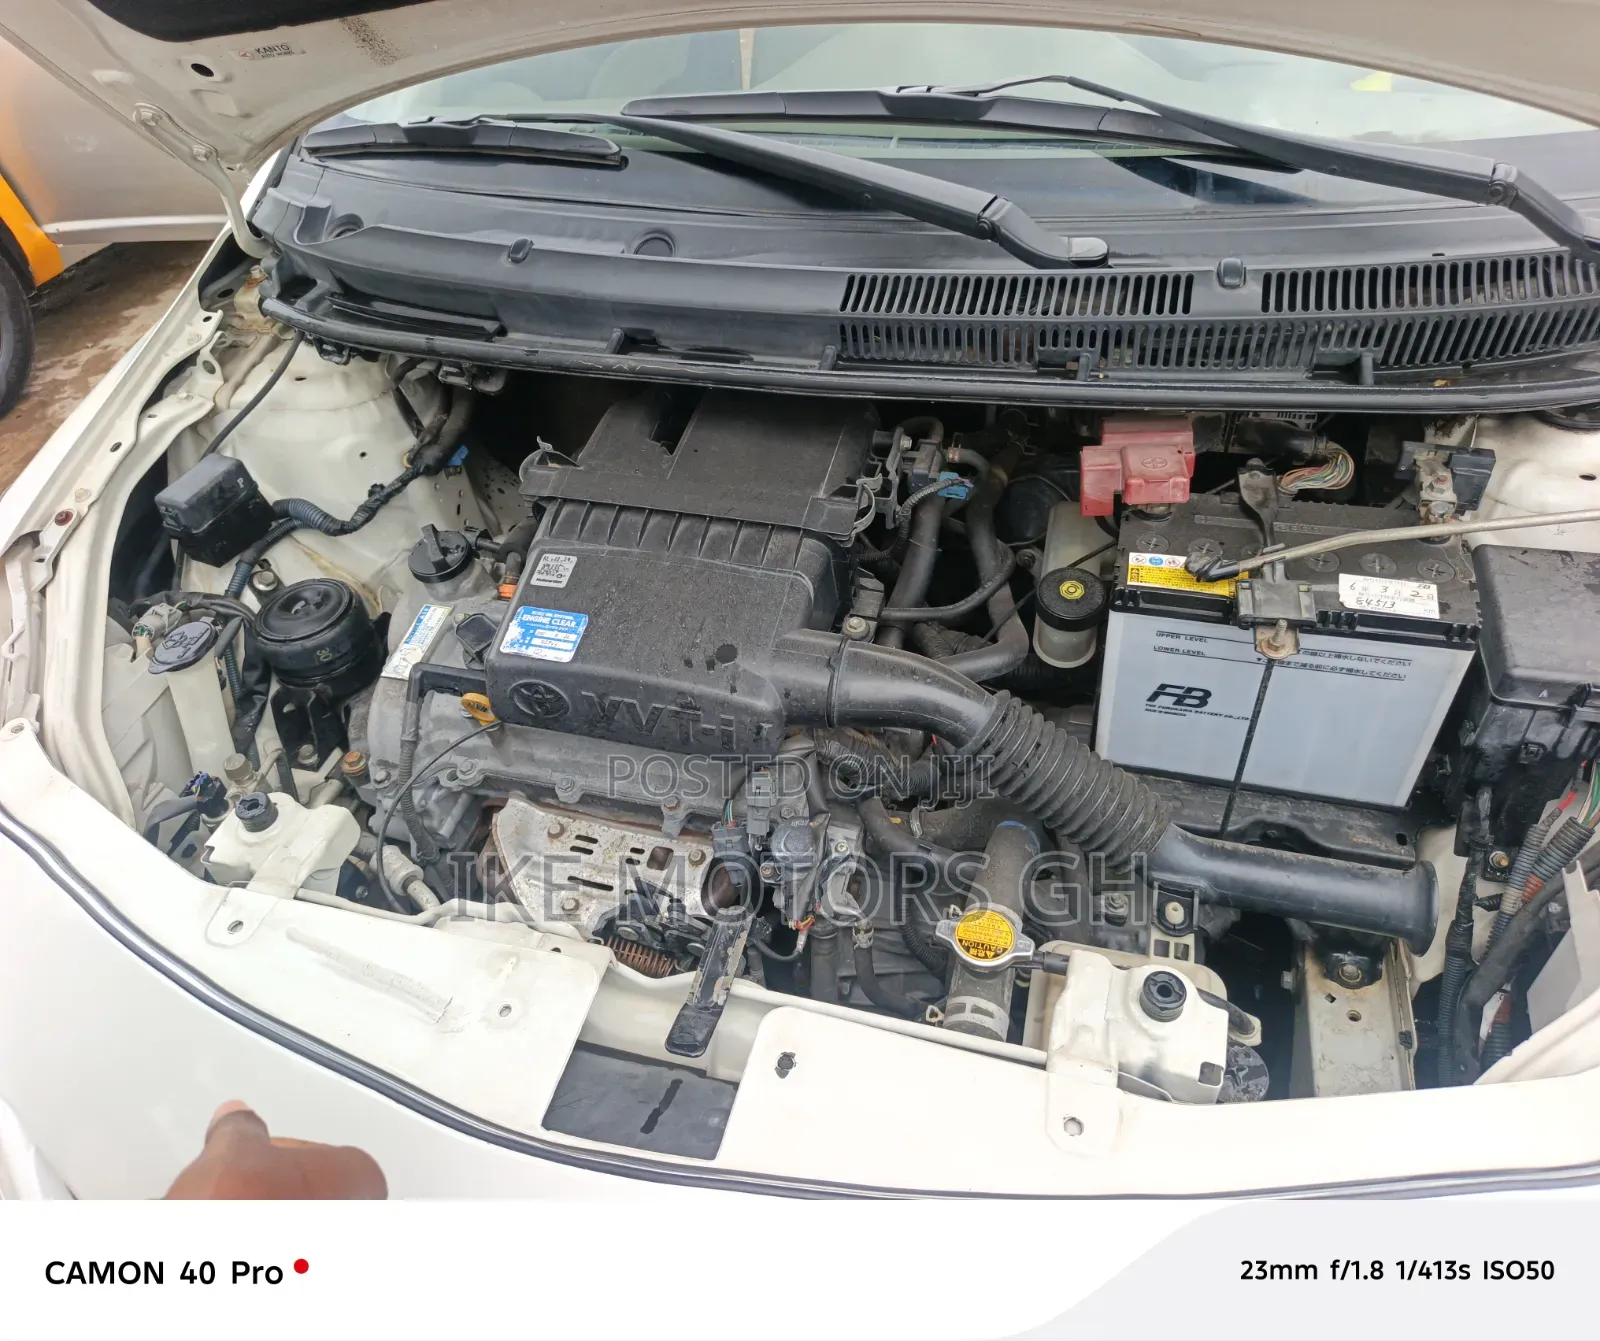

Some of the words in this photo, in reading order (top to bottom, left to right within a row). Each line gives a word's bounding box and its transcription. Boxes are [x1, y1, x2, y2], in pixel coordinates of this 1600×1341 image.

[254, 44, 290, 54] KANTO
[1349, 582, 1357, 591] 6
[1380, 586, 1389, 594] 3
[1410, 590, 1423, 598] 2
[521, 614, 552, 625] ENGINE
[551, 618, 577, 628] CLEAR
[1155, 631, 1182, 640] UPPER
[1184, 635, 1208, 643] LEVEL
[1153, 645, 1180, 653] LOWER
[1146, 683, 1213, 709] FB
[961, 939, 1003, 954] CAUTION
